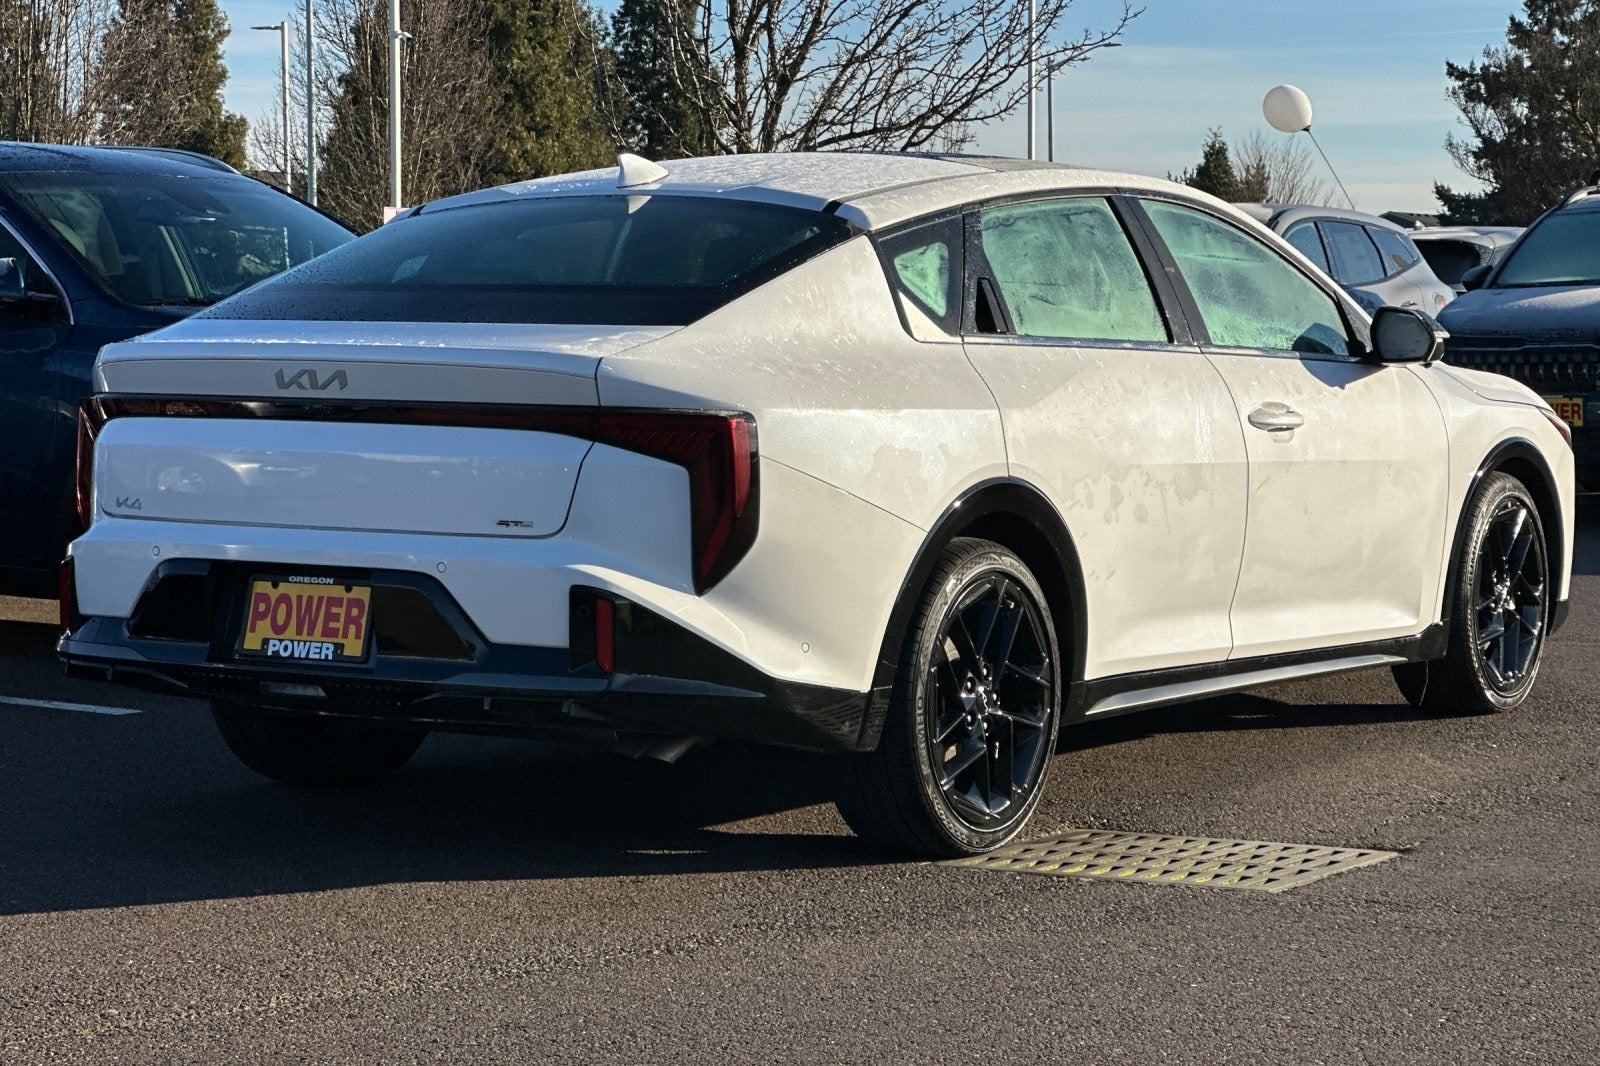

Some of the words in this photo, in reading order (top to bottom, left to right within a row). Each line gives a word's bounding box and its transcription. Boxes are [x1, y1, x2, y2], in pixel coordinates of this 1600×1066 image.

[274, 368, 348, 390] KIA
[288, 575, 334, 585] OREGON
[248, 591, 366, 641] POWER
[267, 639, 335, 660] POWER
